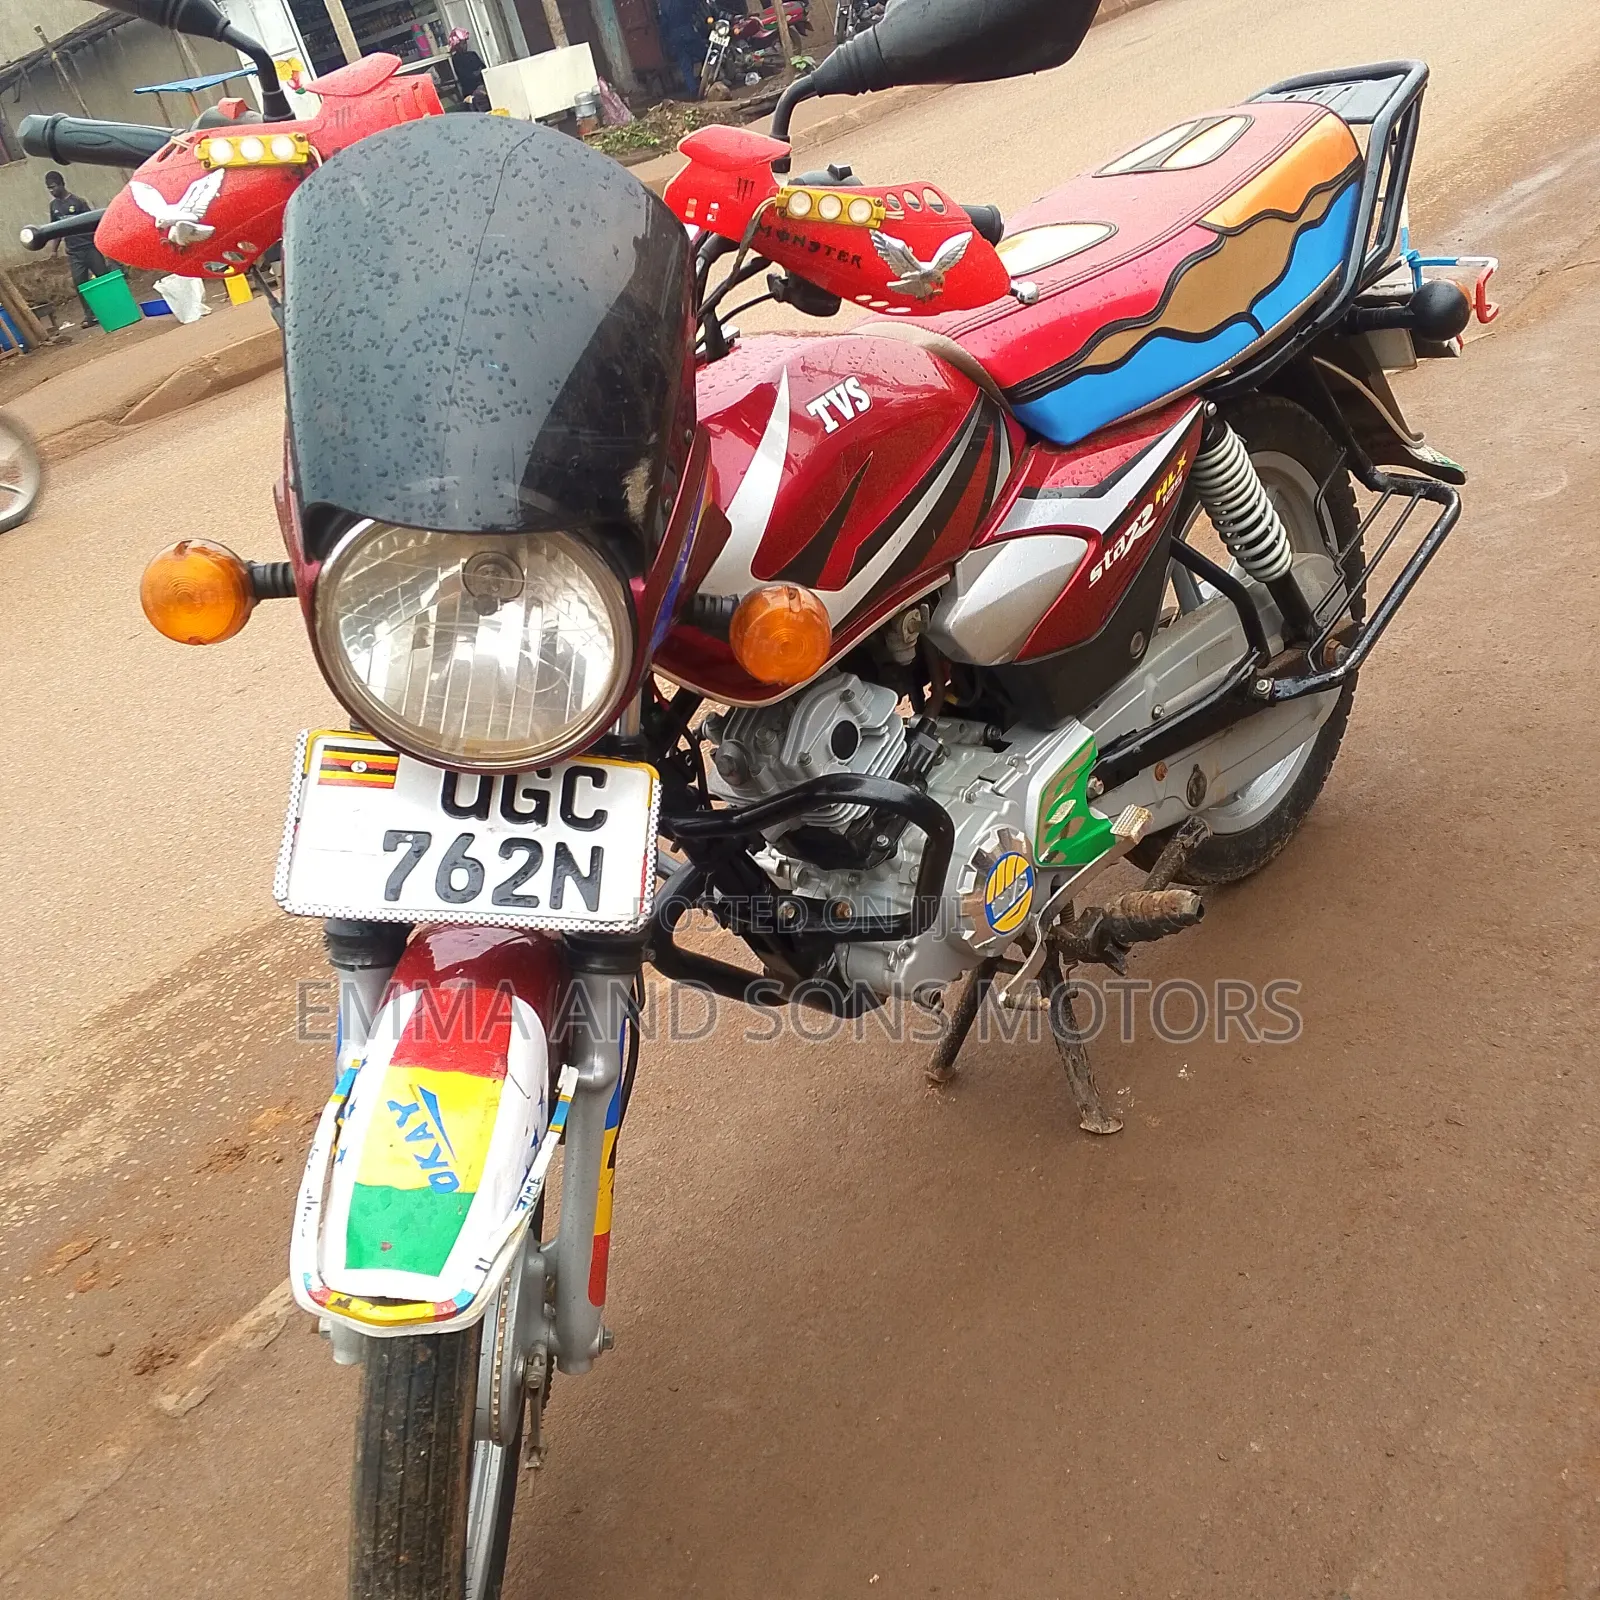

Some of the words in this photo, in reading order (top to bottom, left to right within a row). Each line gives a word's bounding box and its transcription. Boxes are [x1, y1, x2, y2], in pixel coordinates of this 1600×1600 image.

[755, 221, 863, 268] MONSTER
[805, 375, 872, 434] TVS
[441, 765, 609, 833] UGC
[383, 830, 605, 912] 762N
[387, 1100, 460, 1195] OKAY
